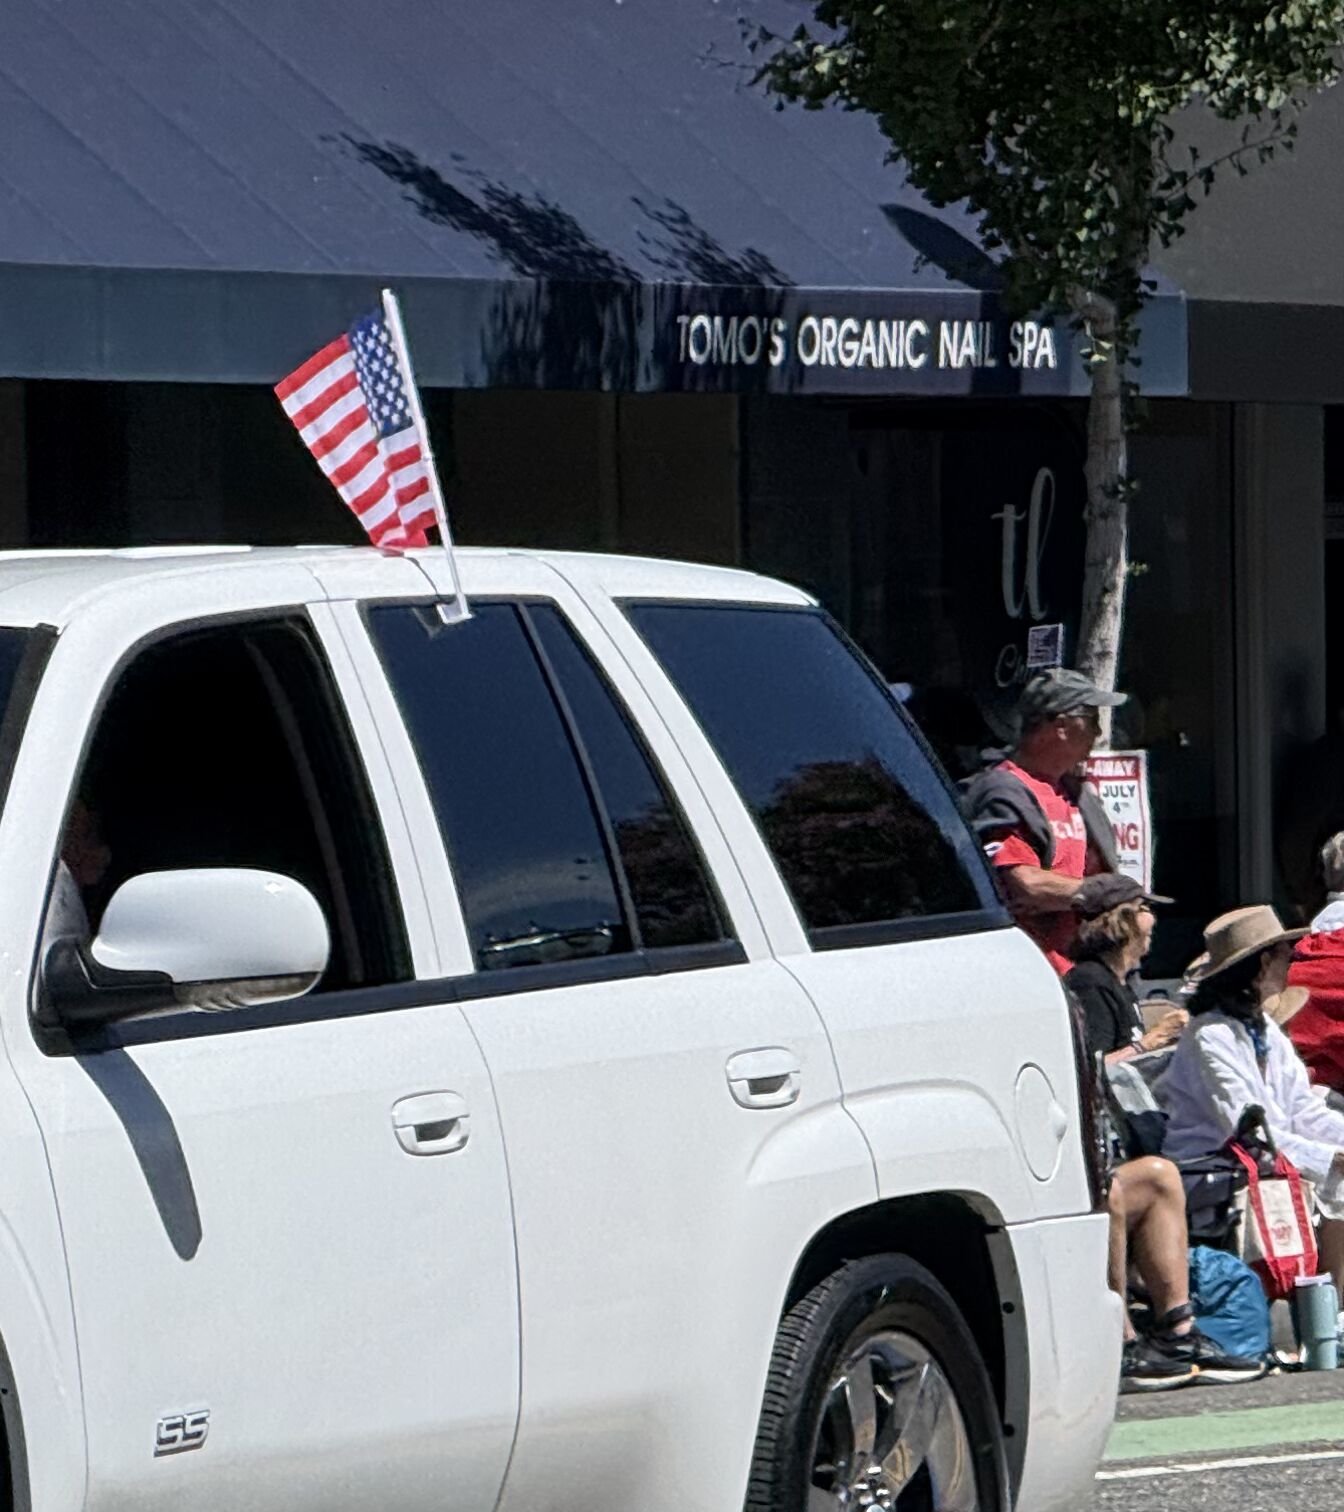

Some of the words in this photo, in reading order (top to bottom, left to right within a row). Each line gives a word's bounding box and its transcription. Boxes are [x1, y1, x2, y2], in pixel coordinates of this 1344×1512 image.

[676, 313, 787, 367] TOMO'S
[797, 315, 928, 369] ORGANIC
[938, 319, 997, 369] NAIL
[1008, 320, 1058, 369] SPA
[1101, 784, 1137, 799] JULY
[152, 1408, 212, 1458] SS
